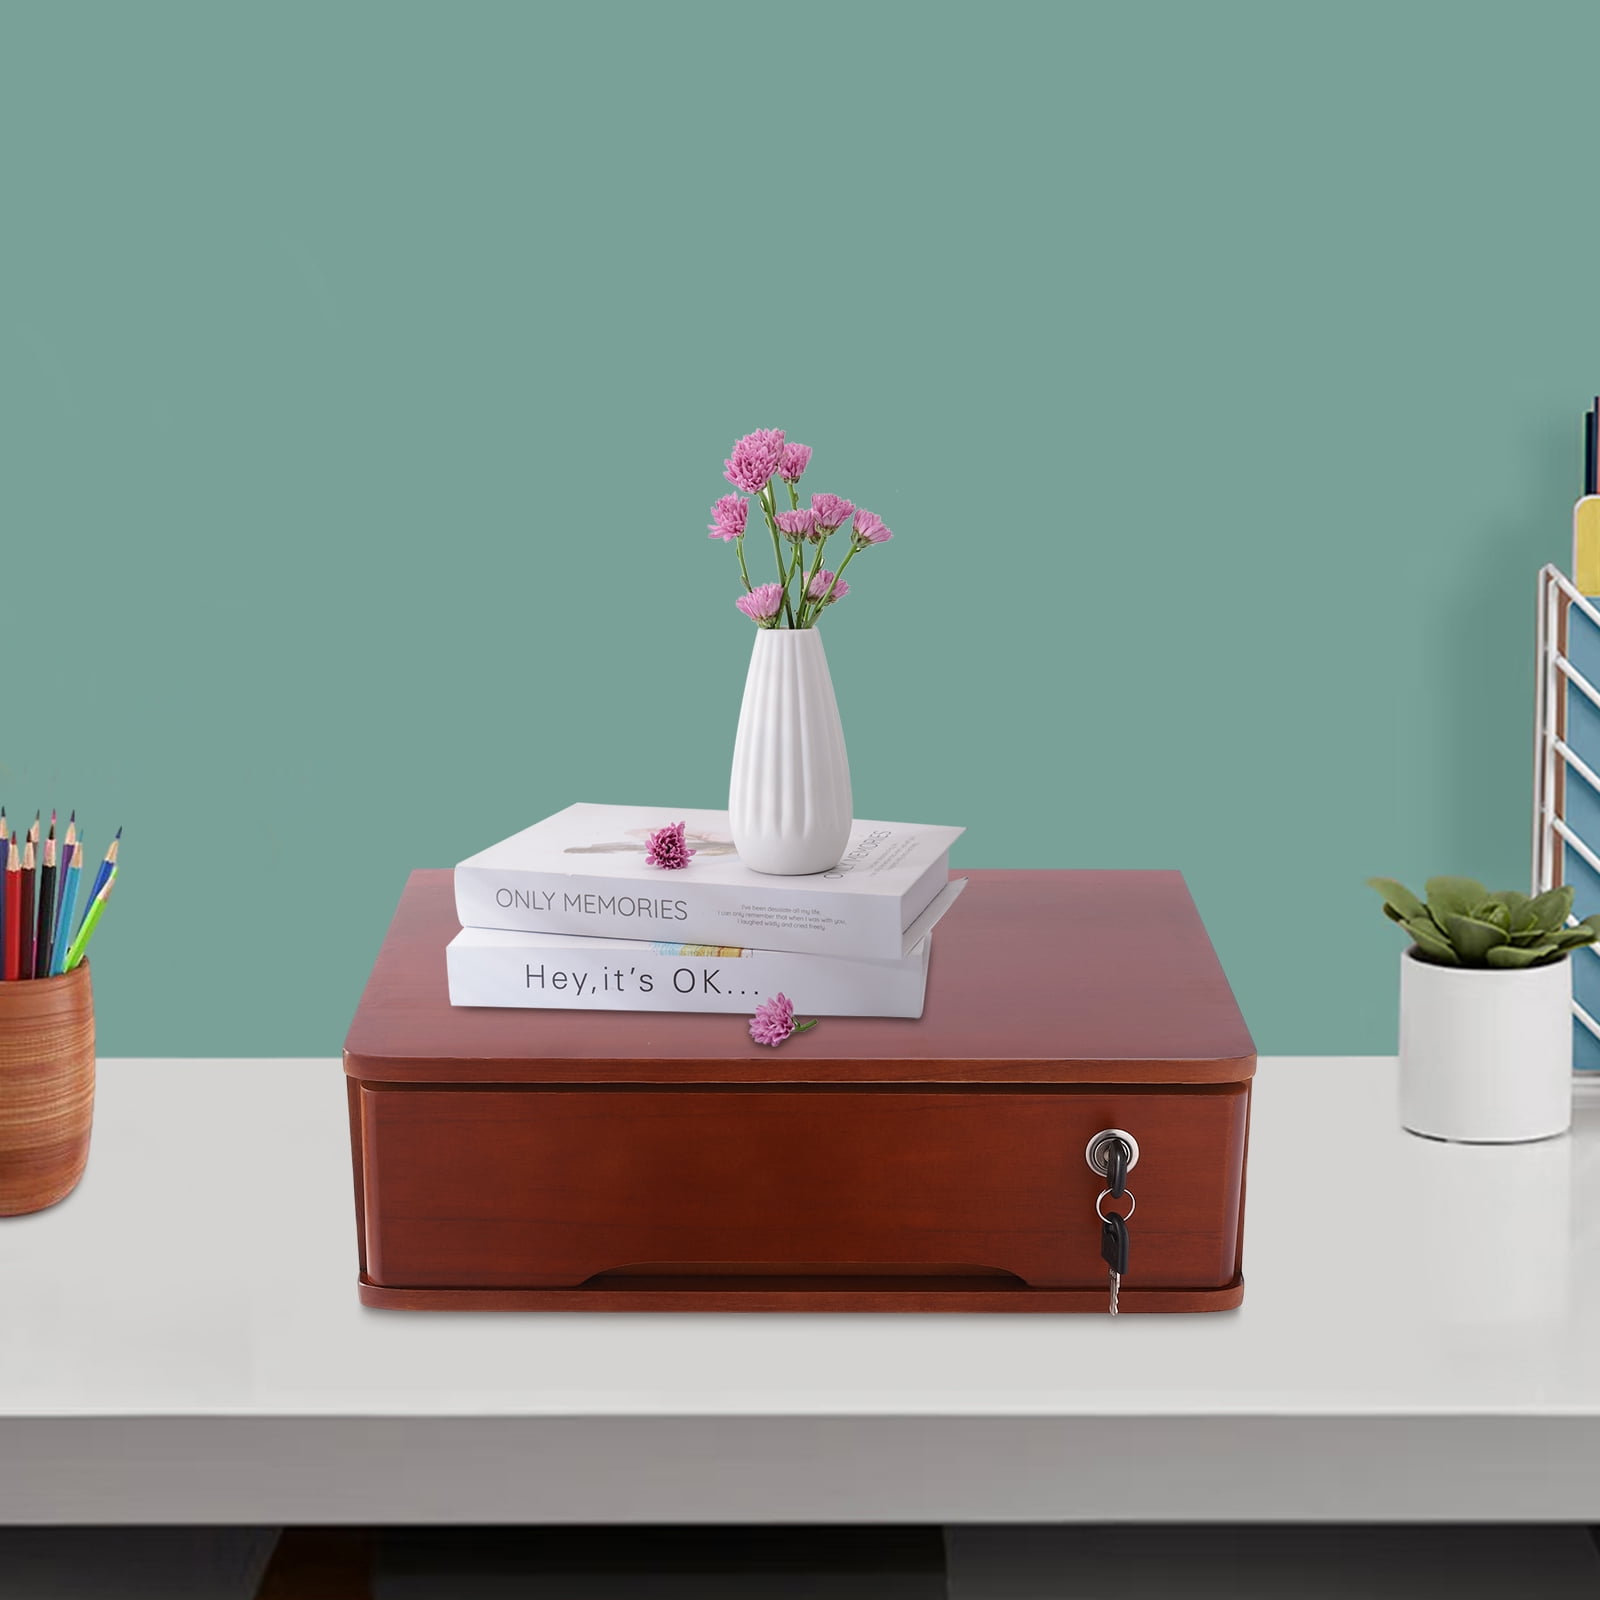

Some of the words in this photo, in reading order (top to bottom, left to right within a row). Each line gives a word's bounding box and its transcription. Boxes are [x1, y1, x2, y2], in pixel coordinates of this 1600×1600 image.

[495, 888, 555, 911] ONLY
[563, 893, 688, 921] MEMORIES
[745, 912, 775, 920] remember
[740, 918, 764, 927] laughed
